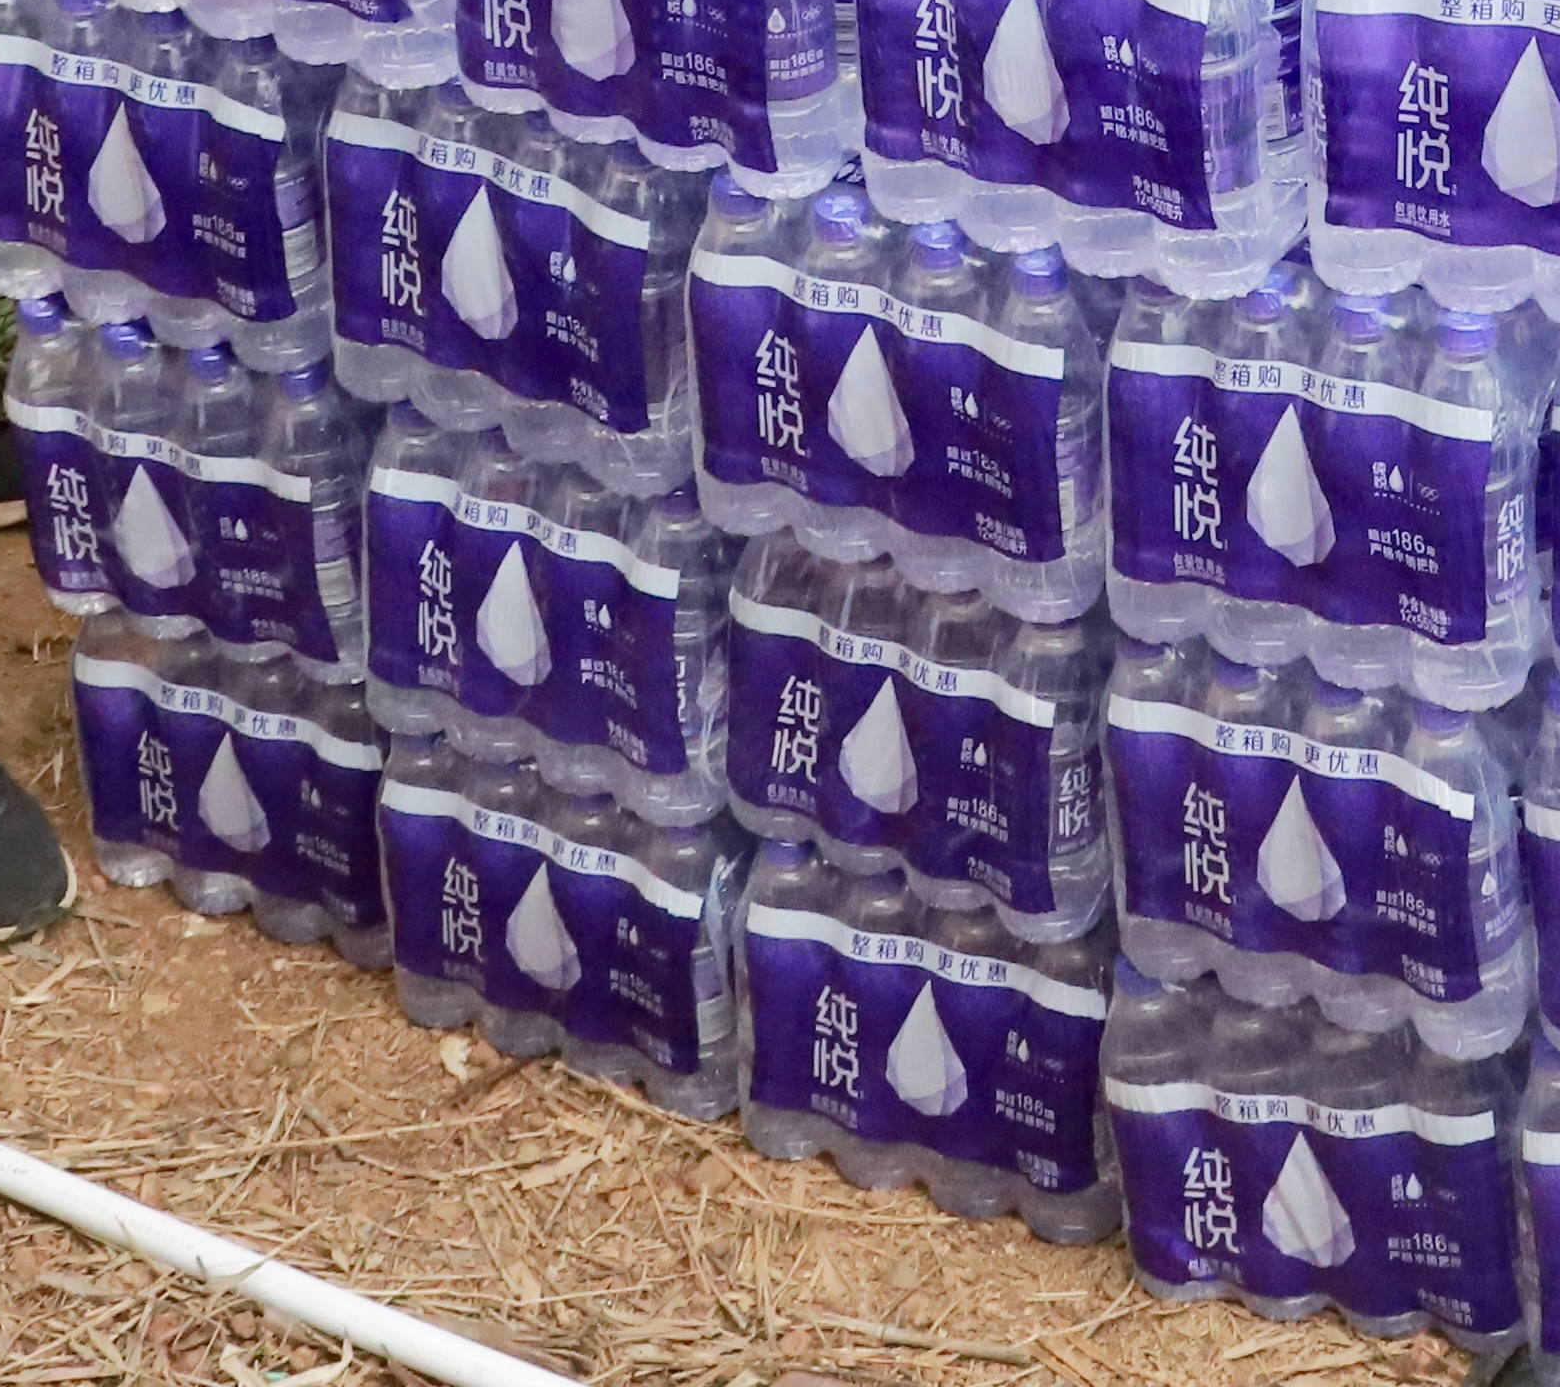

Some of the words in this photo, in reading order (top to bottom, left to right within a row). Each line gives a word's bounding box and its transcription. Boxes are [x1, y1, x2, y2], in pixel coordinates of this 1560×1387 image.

[51, 53, 120, 85] 整箱购
[25, 107, 65, 224] 纯悦
[1396, 60, 1451, 196] 纯悦
[382, 189, 427, 317] 纯悦
[755, 329, 806, 456] 纯悦
[1301, 374, 1367, 408] 更优惠
[47, 463, 102, 563] 纯悦
[1173, 415, 1224, 551] 纯悦
[1497, 493, 1526, 582] 纯悦
[137, 730, 179, 832] 纯悦
[771, 675, 821, 784] 纯悦
[1215, 724, 1291, 755] 整箱购
[1304, 742, 1380, 776] 更优惠
[1183, 781, 1233, 905] 纯悦
[441, 857, 483, 963] 纯悦
[851, 933, 925, 963] 整箱购
[936, 952, 1007, 982] 更优惠
[813, 985, 860, 1098] 纯悦
[1182, 1147, 1239, 1253] 纯悦
